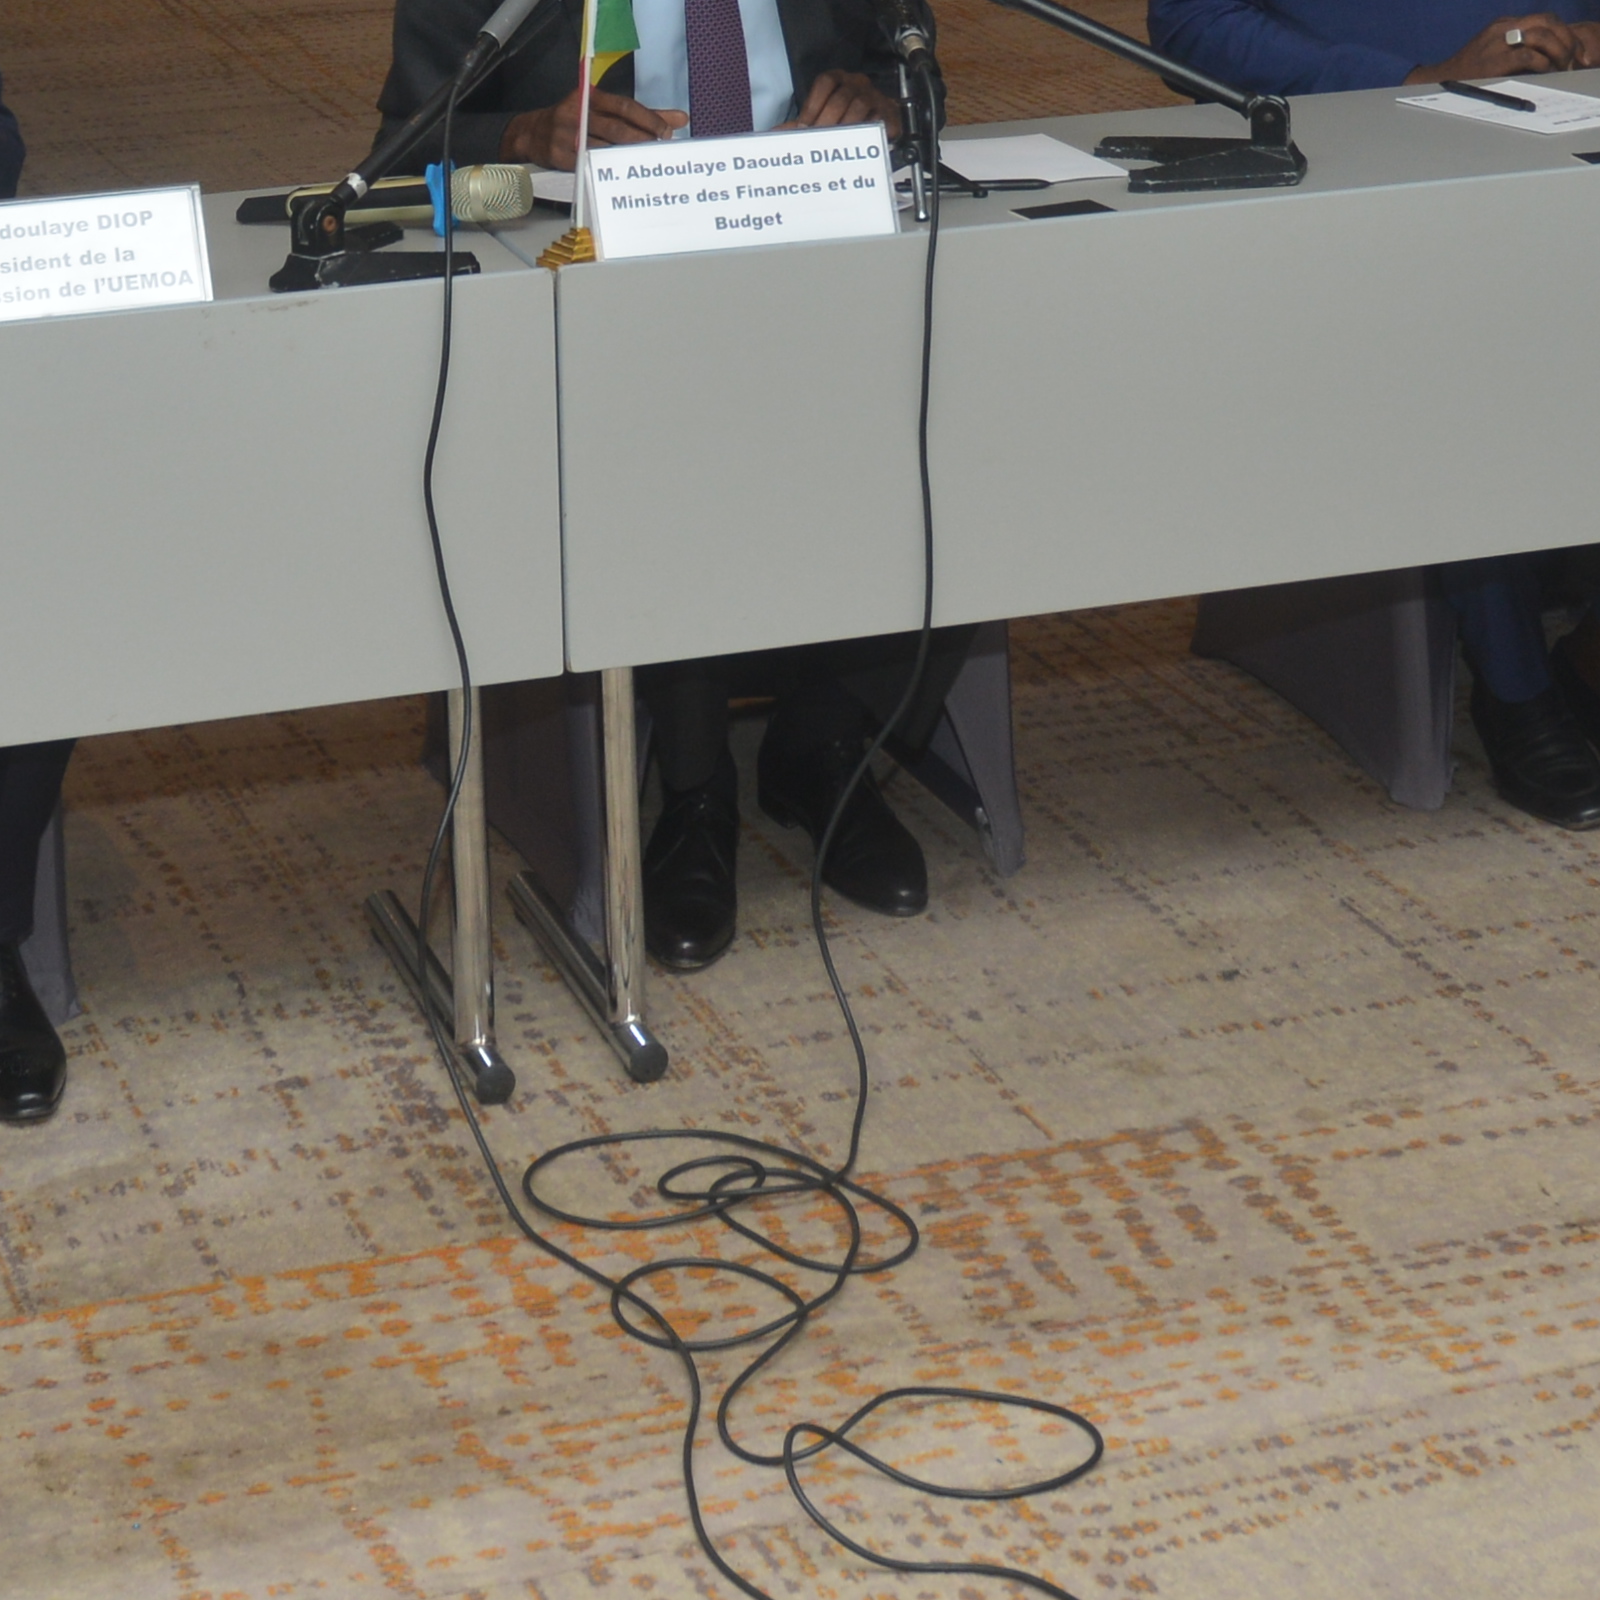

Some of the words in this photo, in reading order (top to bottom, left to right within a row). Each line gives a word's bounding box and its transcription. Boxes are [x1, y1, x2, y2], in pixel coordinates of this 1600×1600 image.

[597, 167, 620, 182] M.
[627, 159, 727, 181] Abdoulaye
[733, 153, 804, 171] Daouda
[810, 144, 881, 164] DIALLO
[611, 189, 690, 211] Ministre
[696, 187, 730, 203] des
[736, 180, 822, 200] Finances
[828, 176, 847, 191] et
[852, 175, 876, 190] du
[97, 210, 154, 231] DIOP
[715, 211, 783, 232] Budget
[79, 248, 107, 267] de
[114, 246, 136, 263] la
[58, 280, 87, 298] de
